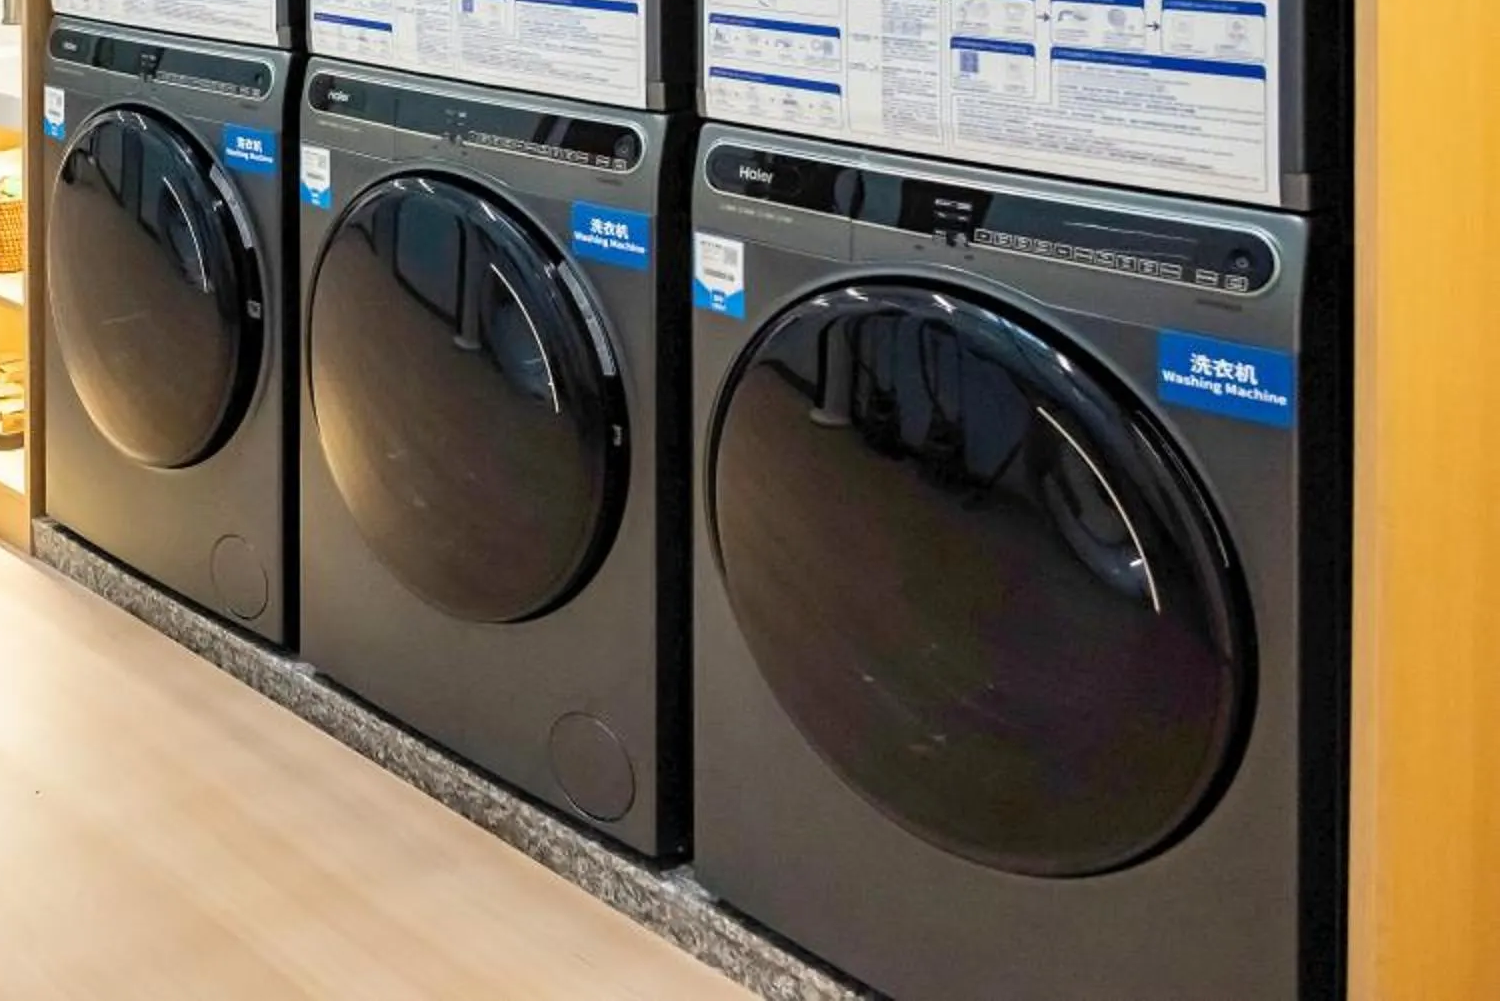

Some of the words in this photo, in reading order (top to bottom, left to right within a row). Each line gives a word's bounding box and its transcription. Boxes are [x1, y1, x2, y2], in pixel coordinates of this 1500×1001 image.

[739, 165, 773, 183] Haier
[1190, 353, 1258, 386] 洗衣机
[1161, 368, 1222, 395] Washing
[1225, 382, 1287, 406] Machine
